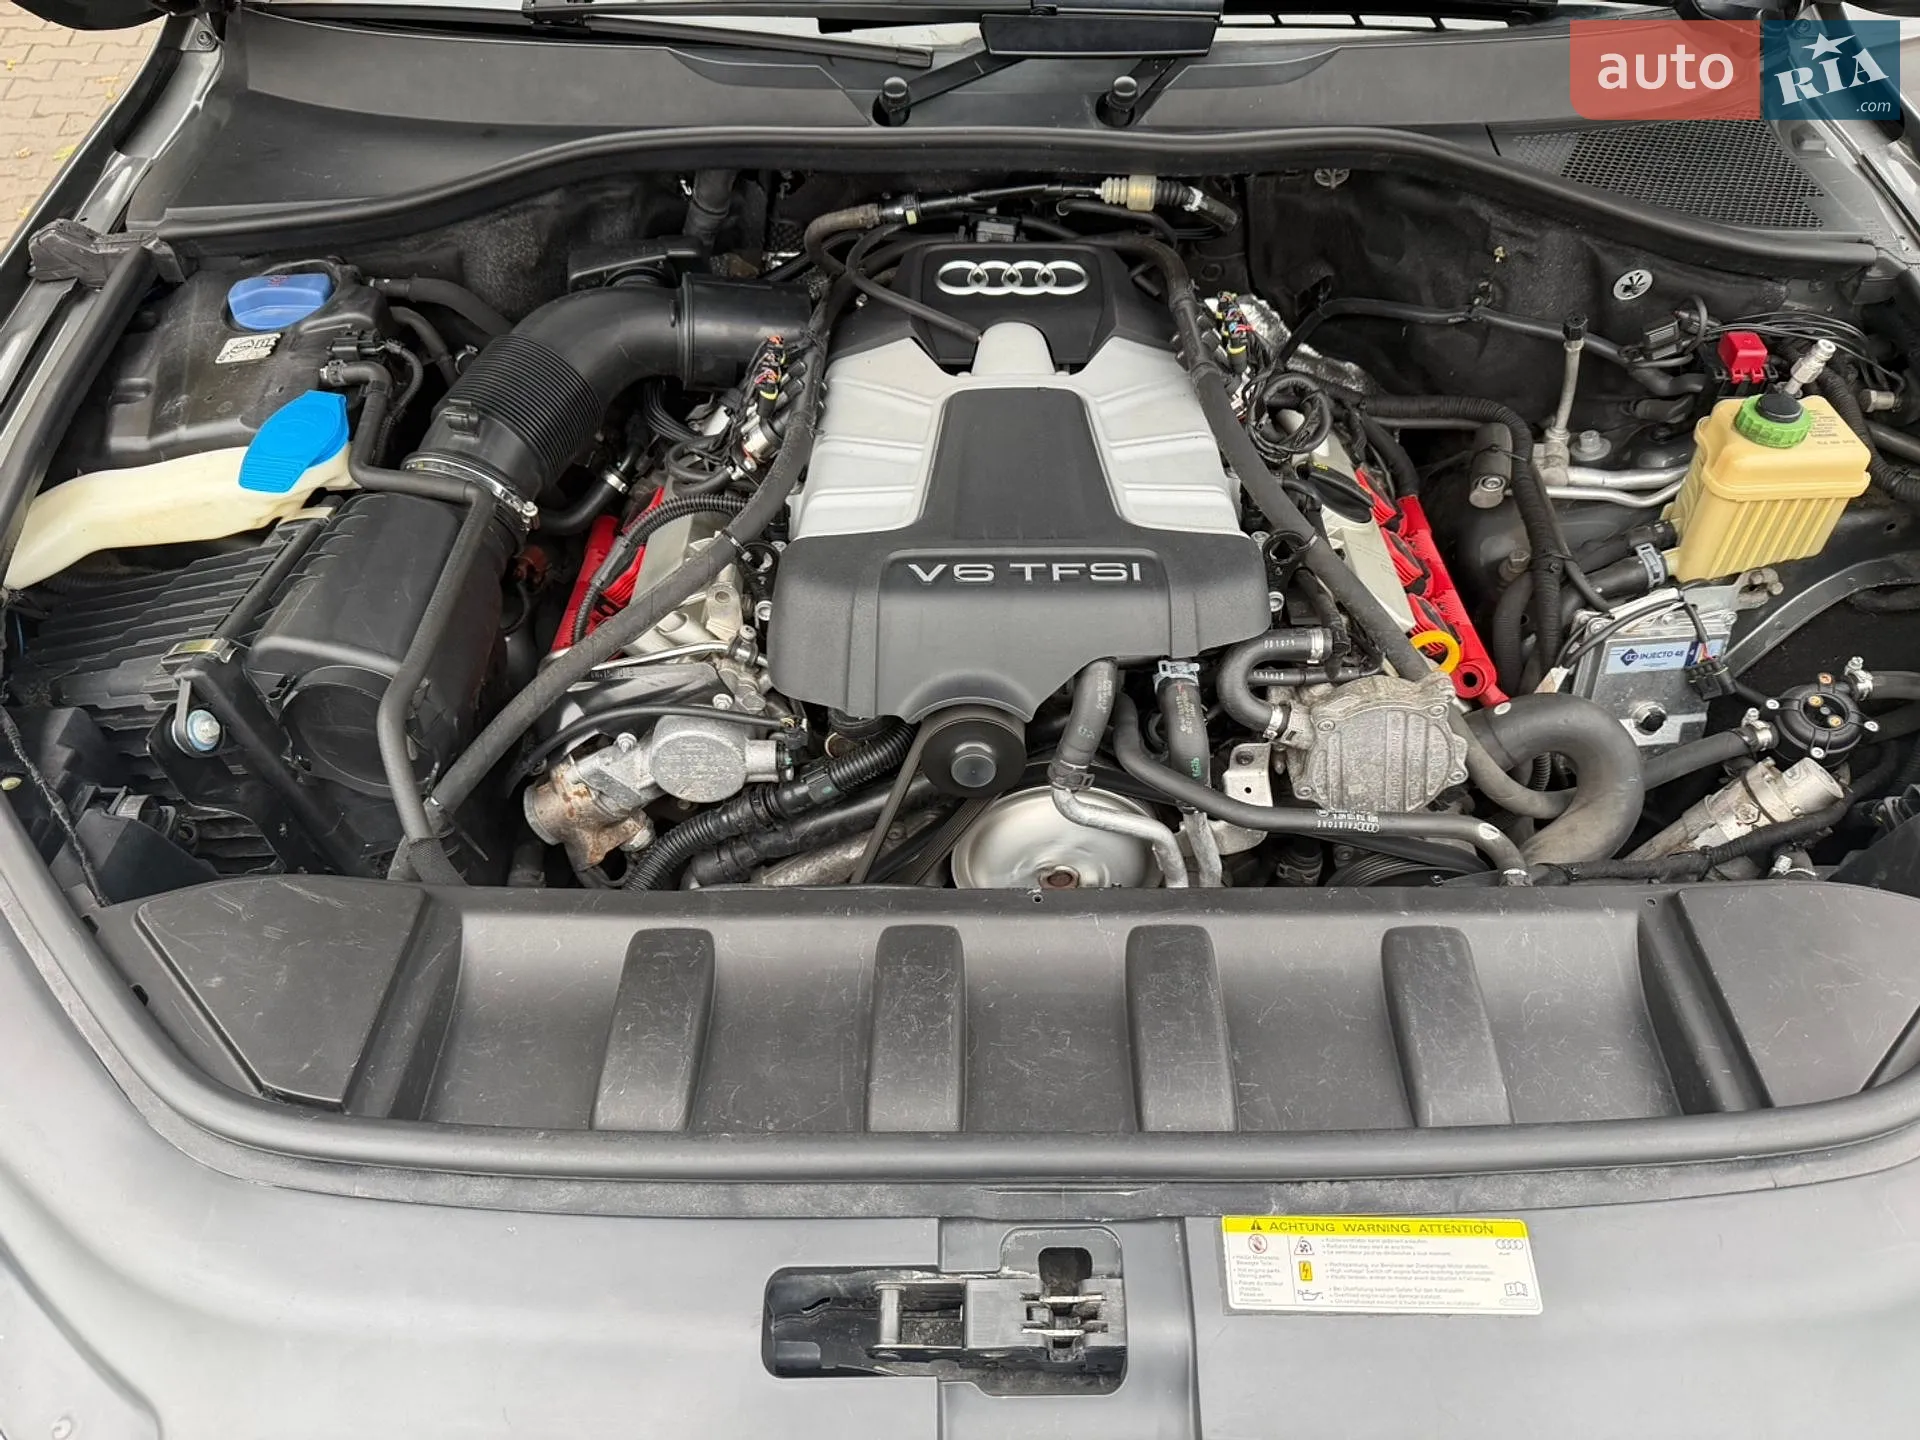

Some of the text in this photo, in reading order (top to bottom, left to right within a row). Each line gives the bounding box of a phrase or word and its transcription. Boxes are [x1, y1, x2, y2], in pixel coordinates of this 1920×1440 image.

[907, 562, 1142, 583] V6 TFSI
[1269, 1222, 1495, 1235] ACHTUNG WARNING ATTENTION
